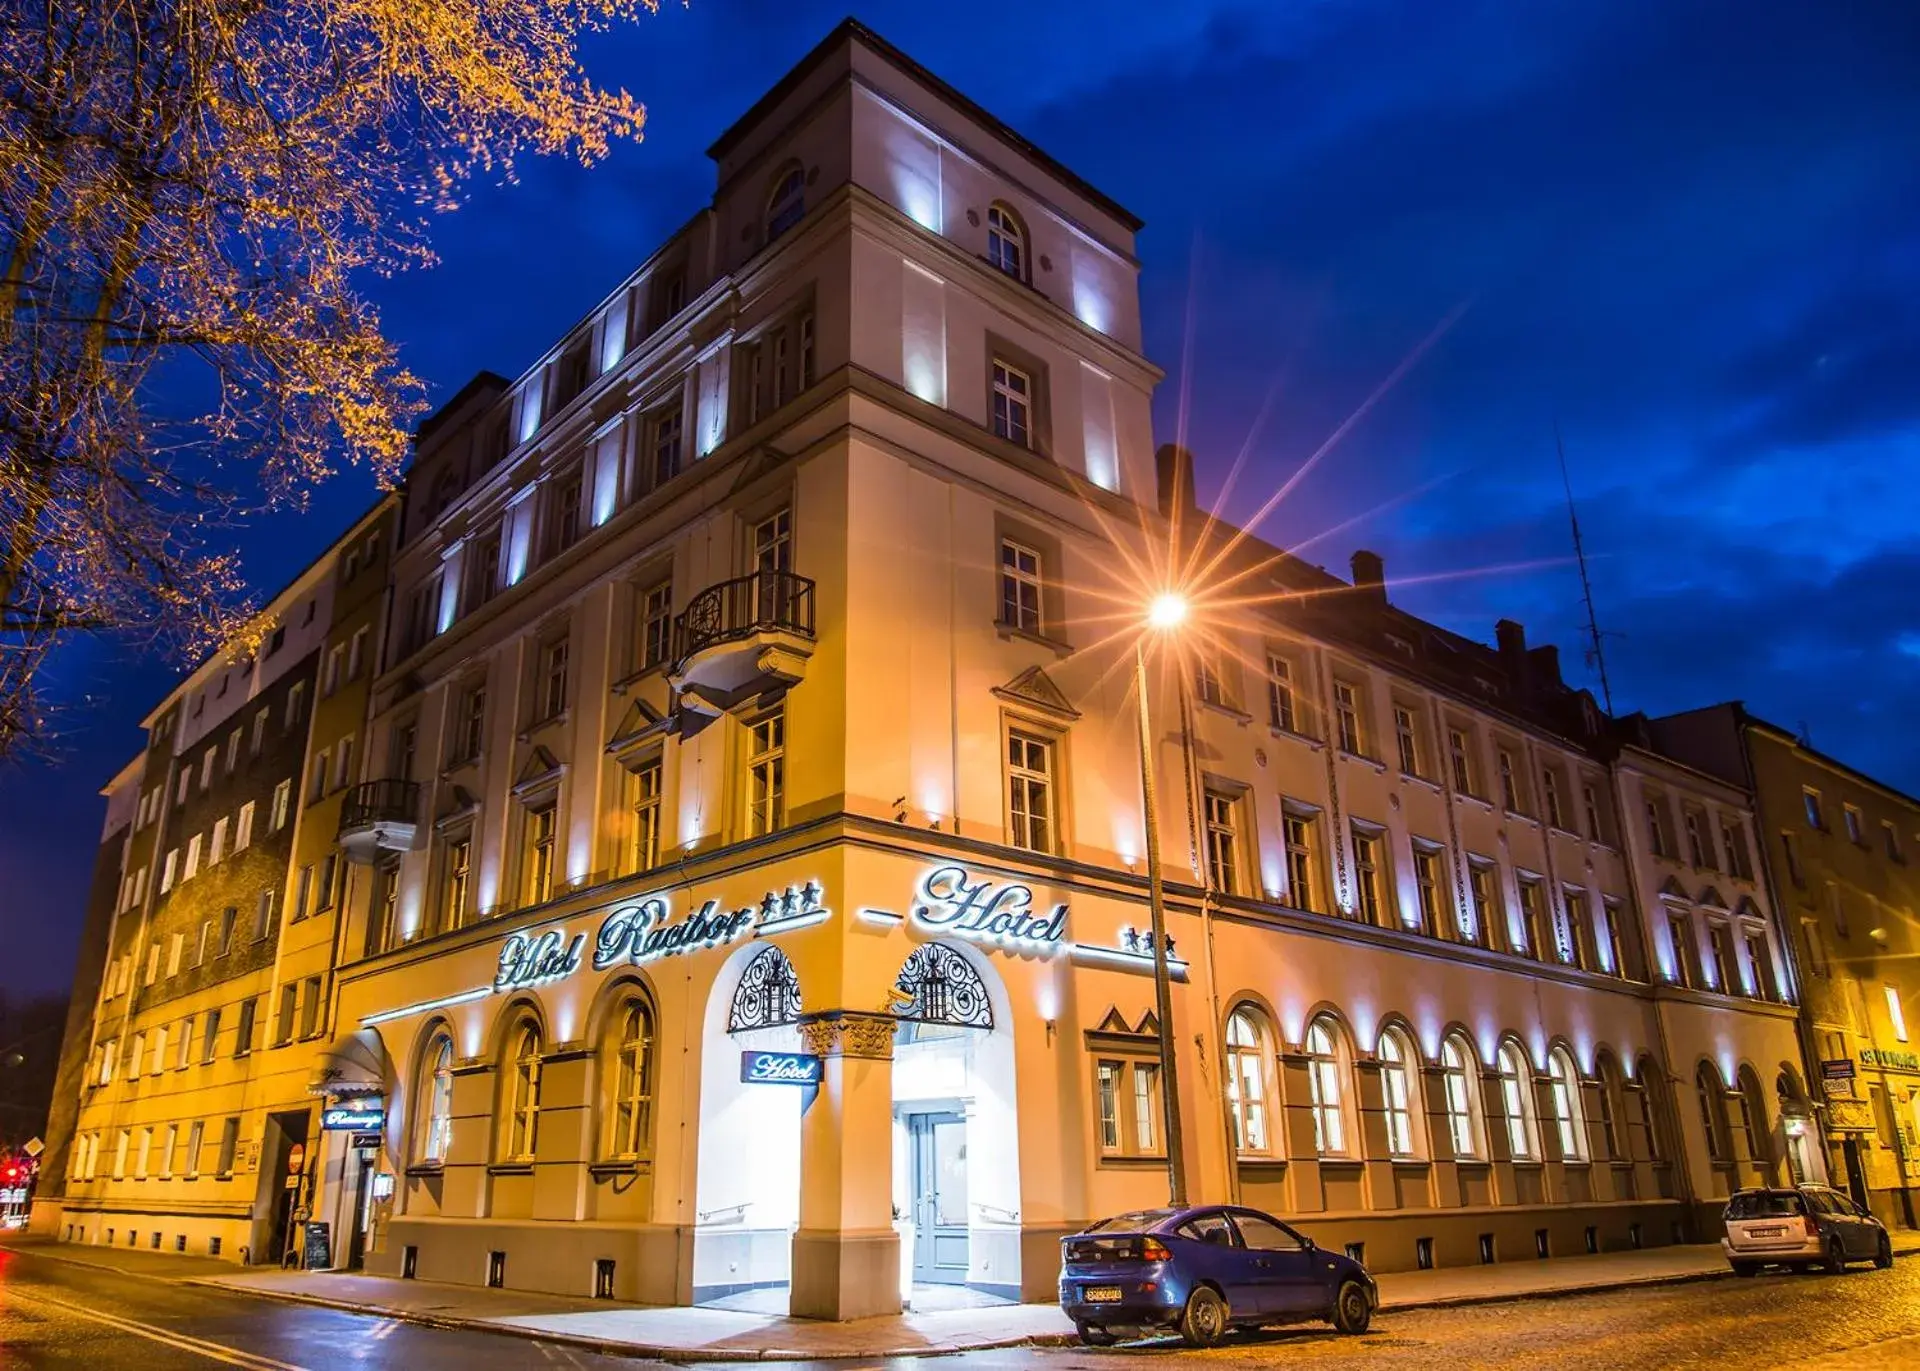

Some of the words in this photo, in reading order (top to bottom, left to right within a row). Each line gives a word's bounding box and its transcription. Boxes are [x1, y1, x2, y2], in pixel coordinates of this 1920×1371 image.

[914, 866, 1069, 943] Hotel
[494, 930, 586, 991] Hotel
[592, 898, 753, 971] Racibor
[751, 1054, 816, 1079] Hotel
